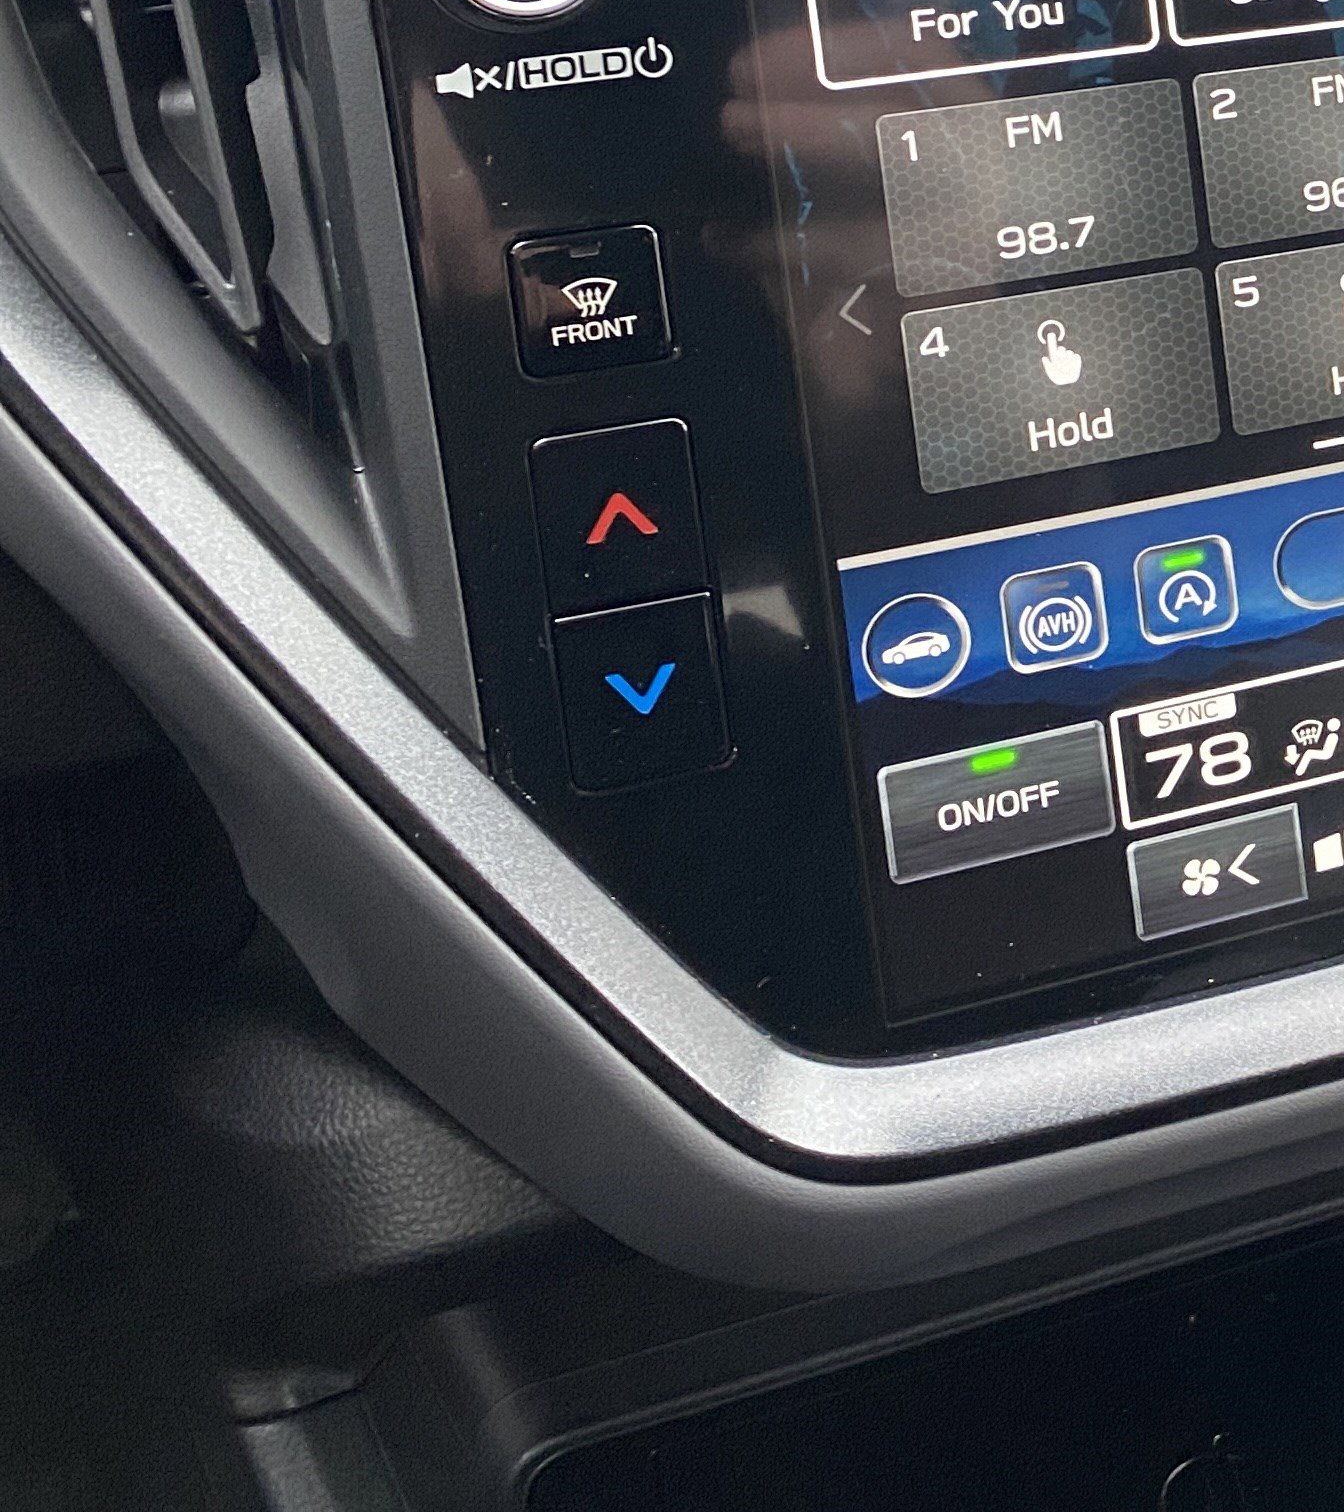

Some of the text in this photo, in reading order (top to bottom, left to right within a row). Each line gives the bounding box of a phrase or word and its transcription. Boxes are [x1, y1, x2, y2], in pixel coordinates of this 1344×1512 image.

[910, 7, 979, 44] For
[1210, 88, 1238, 120] 2
[900, 111, 1063, 162] 1 FM
[996, 215, 1096, 261] 98.7
[1231, 275, 1261, 308] 5
[550, 314, 638, 347] FRONT
[919, 326, 950, 358] 4
[1027, 406, 1115, 452] Hold
[1173, 582, 1201, 609] A
[1038, 610, 1076, 639] AVH
[1156, 698, 1219, 730] SYNC
[1145, 730, 1252, 799] 78
[937, 779, 1060, 832] ON/OFF
